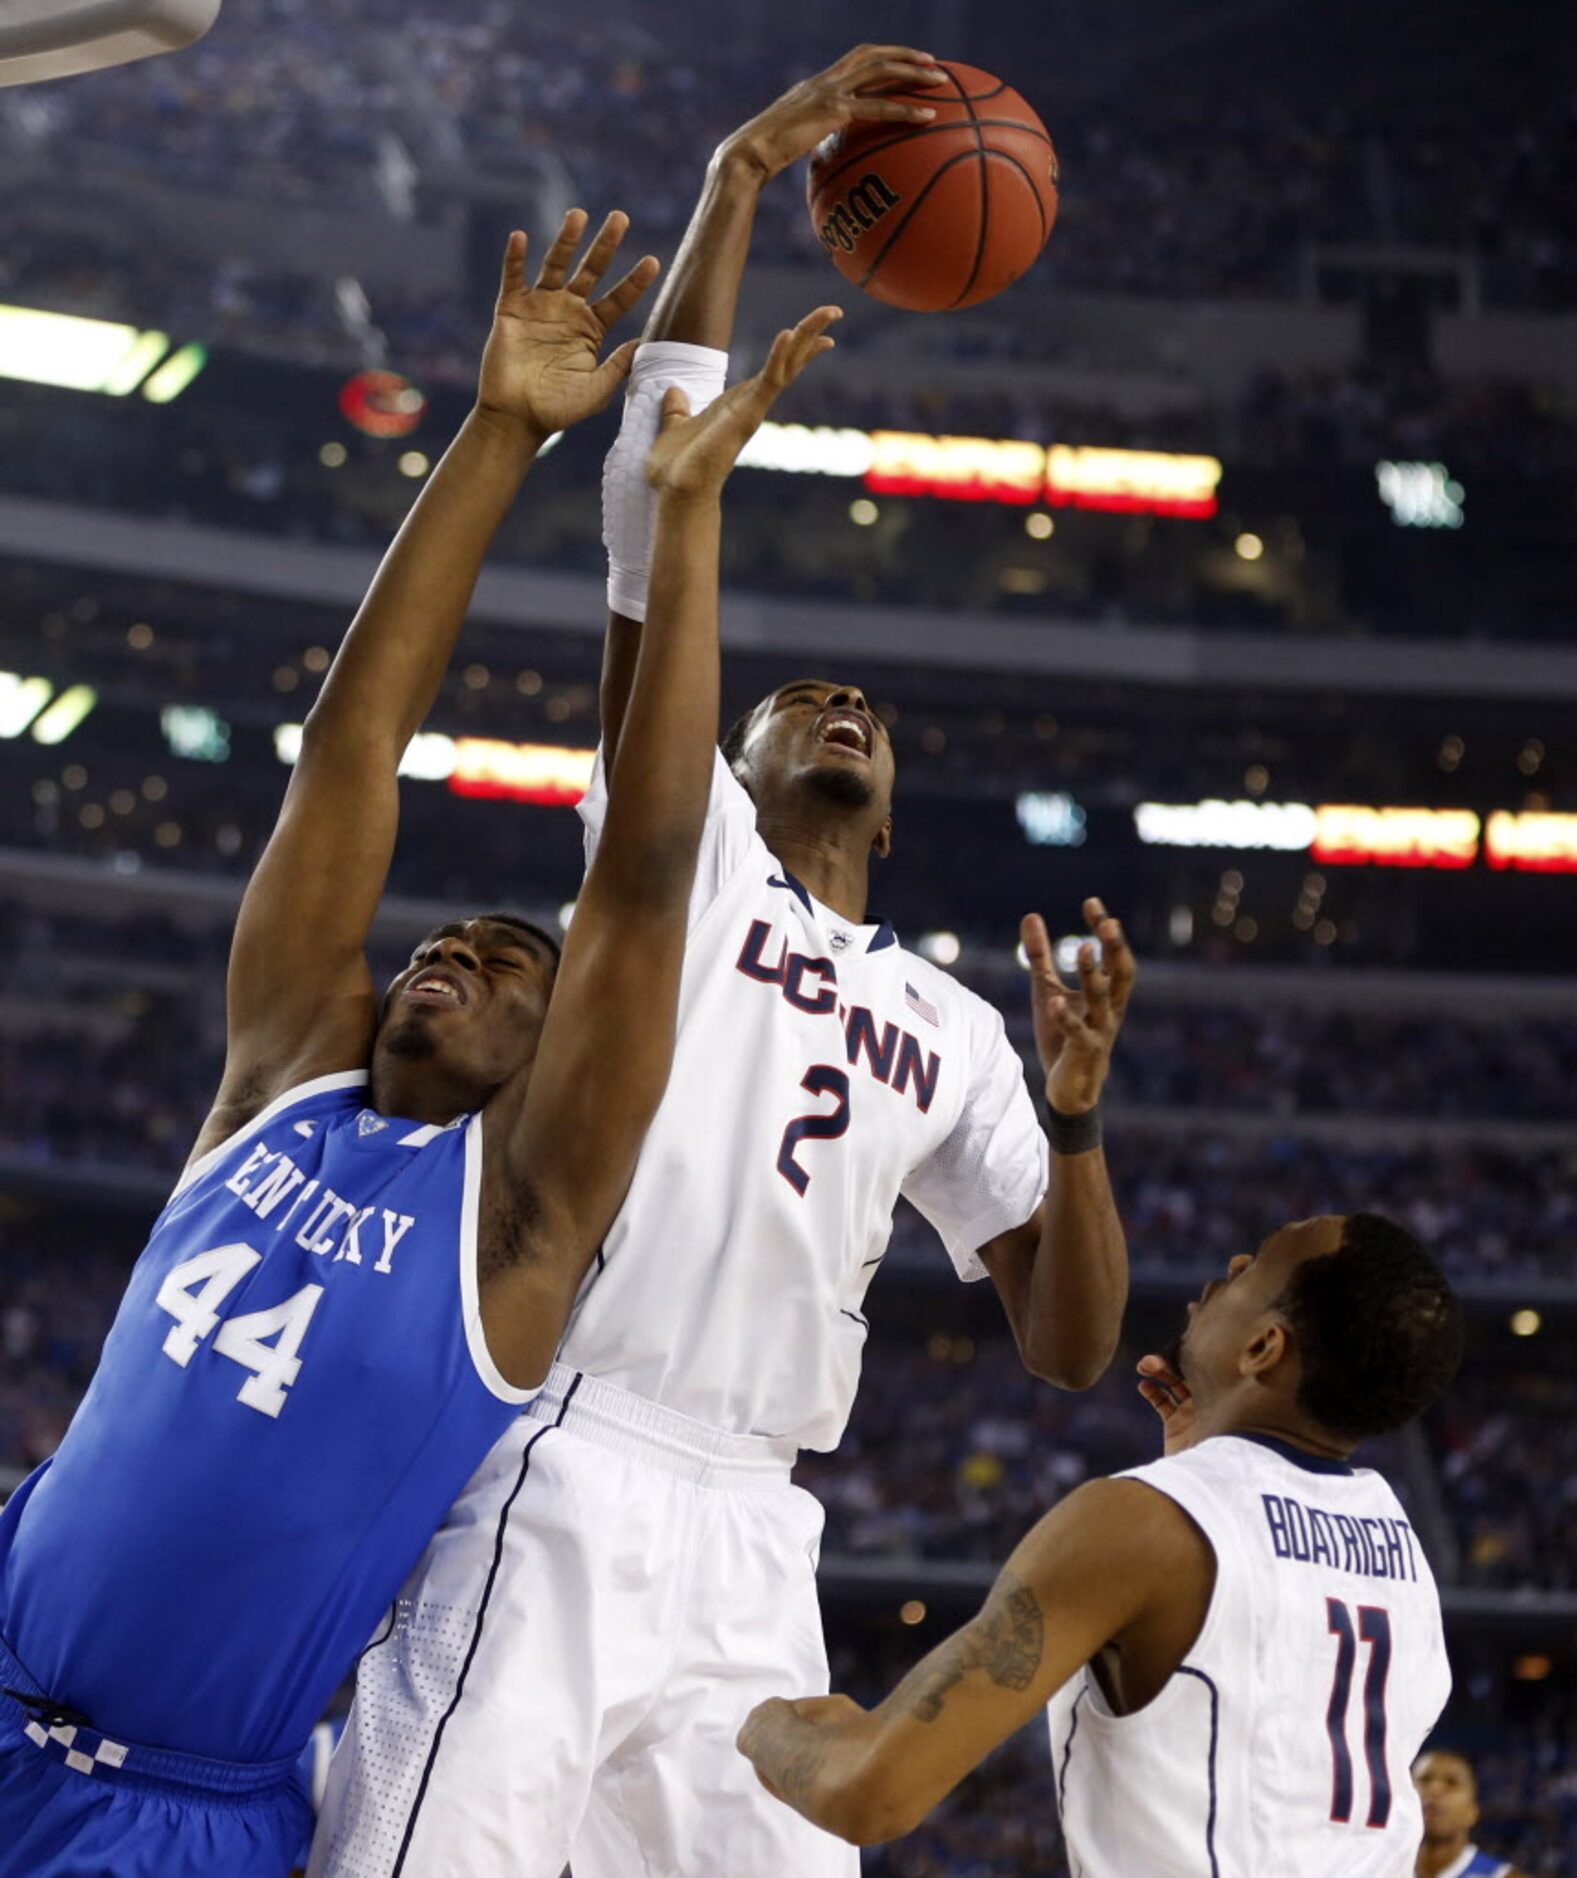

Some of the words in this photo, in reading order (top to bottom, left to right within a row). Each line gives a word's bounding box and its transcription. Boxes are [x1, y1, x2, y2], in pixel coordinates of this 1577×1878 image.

[735, 918, 941, 1114] UCNN
[777, 1064, 850, 1199] 2
[156, 1242, 325, 1418] 44
[1261, 1494, 1417, 1583] BOATRIGHT
[1326, 1597, 1392, 1828] 11
